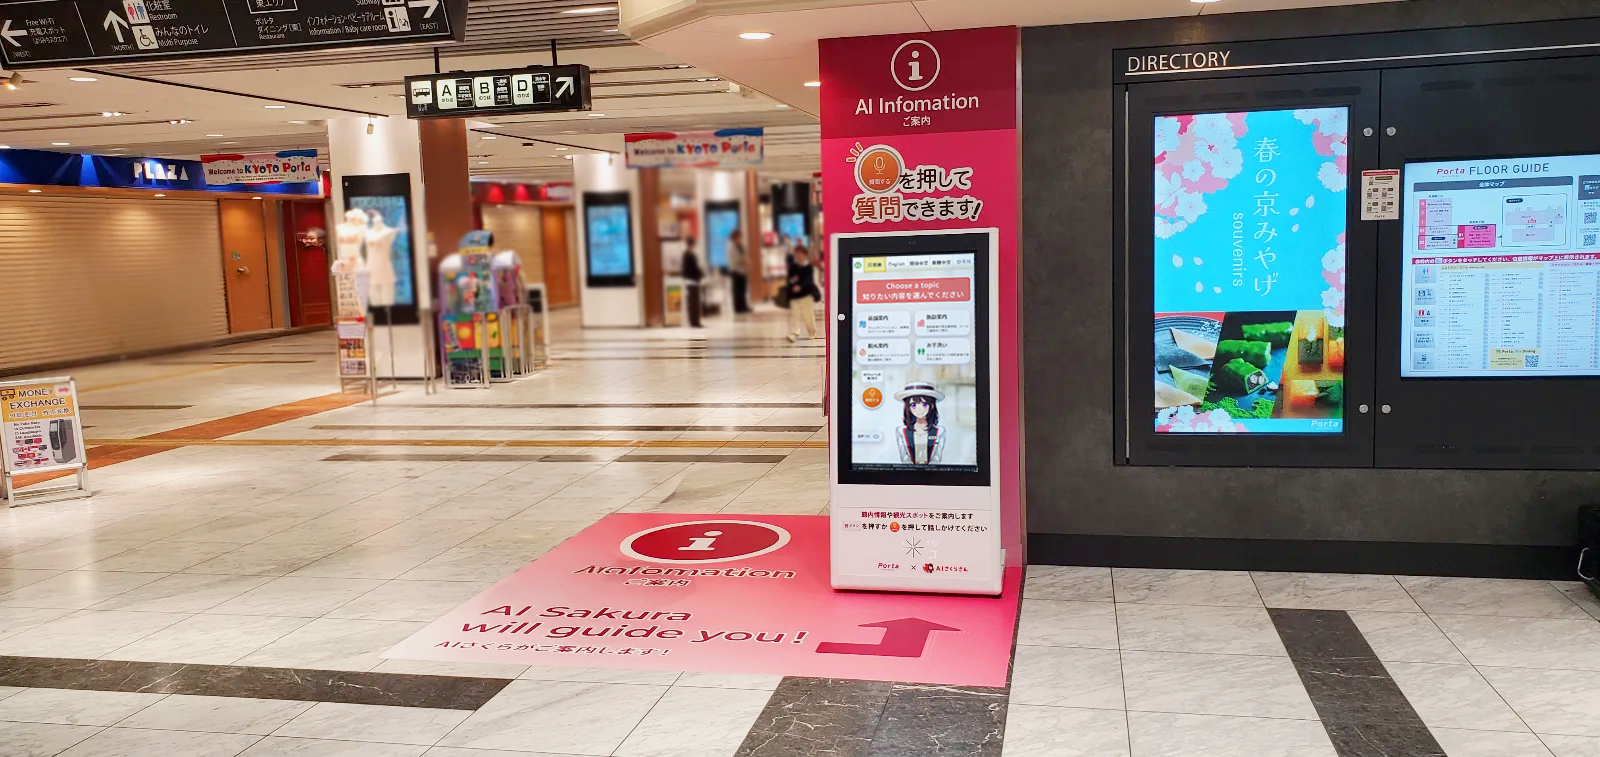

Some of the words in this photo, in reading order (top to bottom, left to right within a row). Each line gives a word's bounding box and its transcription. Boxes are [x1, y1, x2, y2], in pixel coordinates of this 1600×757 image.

[149, 13, 177, 21] Restroom
[29, 27, 66, 35] 充電スポット
[155, 24, 209, 36] みんなのトイレ
[308, 27, 341, 36] Information
[345, 25, 359, 34] Baby
[372, 24, 387, 32] room
[1127, 51, 1231, 72] DIRECTORY
[442, 85, 452, 97] A
[480, 82, 490, 94] B
[517, 79, 528, 91] D
[855, 98, 873, 115] AI
[879, 93, 979, 114] Infomation
[903, 115, 931, 127] ご案内
[132, 161, 189, 181] PLAZA
[244, 164, 279, 174] KYOTO
[282, 162, 311, 173] Porta
[1470, 165, 1508, 175] FLOOR
[1513, 163, 1549, 173] GUIDE
[899, 168, 970, 190] を押して
[1253, 136, 1280, 297] 春の京みやげ
[1232, 212, 1244, 287] souvenirs
[886, 282, 913, 290] Choose
[921, 281, 940, 290] topic
[862, 291, 964, 301] 知りたい内容を選んでください
[18, 388, 53, 397] MONEY
[10, 398, 66, 409] EXCHANGE
[861, 511, 974, 520] 館内情報や観光スポットをご案内します
[901, 523, 987, 532] を押して話しかけてください
[877, 562, 900, 570] Porta
[481, 605, 533, 618] AI
[539, 605, 693, 622] Sakura
[461, 621, 542, 635] will
[547, 623, 686, 641] guide
